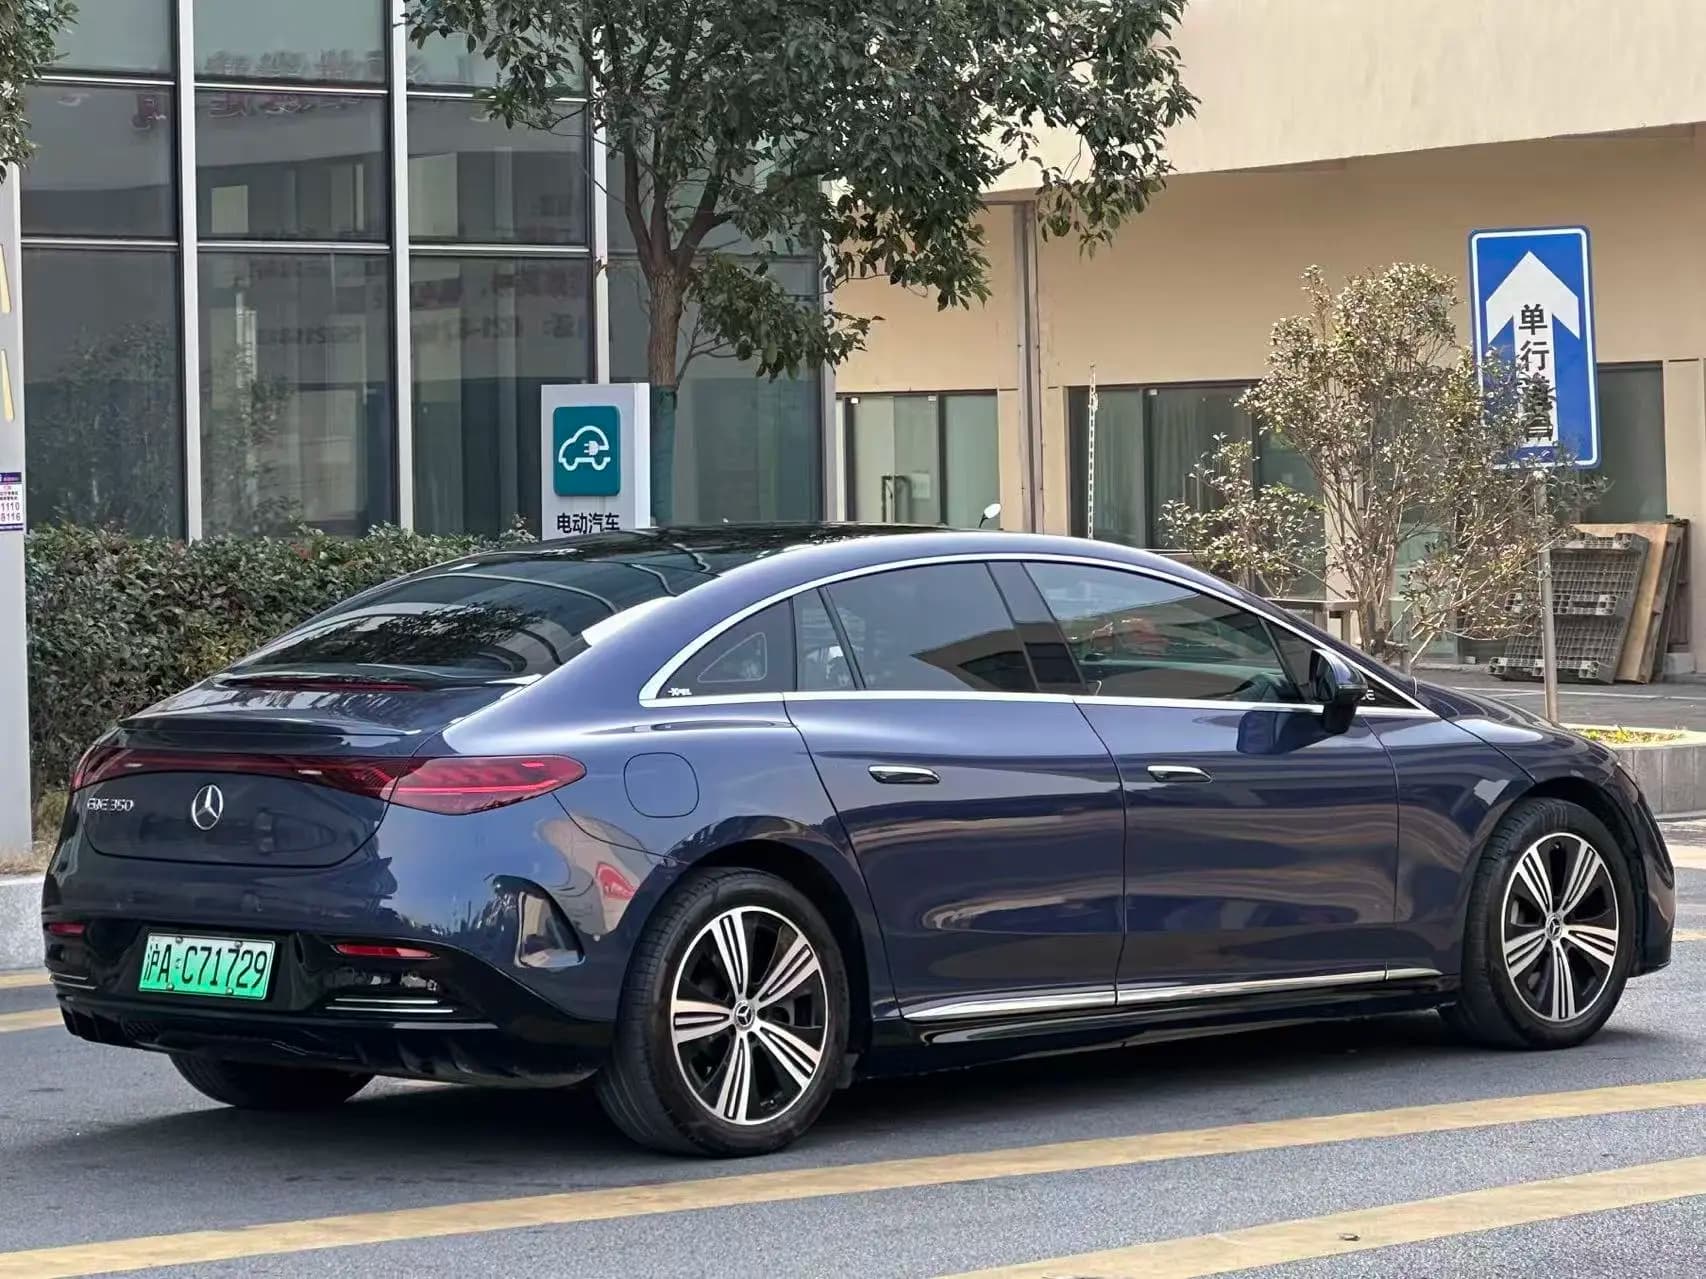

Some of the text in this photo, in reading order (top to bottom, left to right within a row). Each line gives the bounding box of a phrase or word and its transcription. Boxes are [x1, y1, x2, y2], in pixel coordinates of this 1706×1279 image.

[557, 513, 620, 534] 电动汽车
[87, 798, 134, 811] EQE 350
